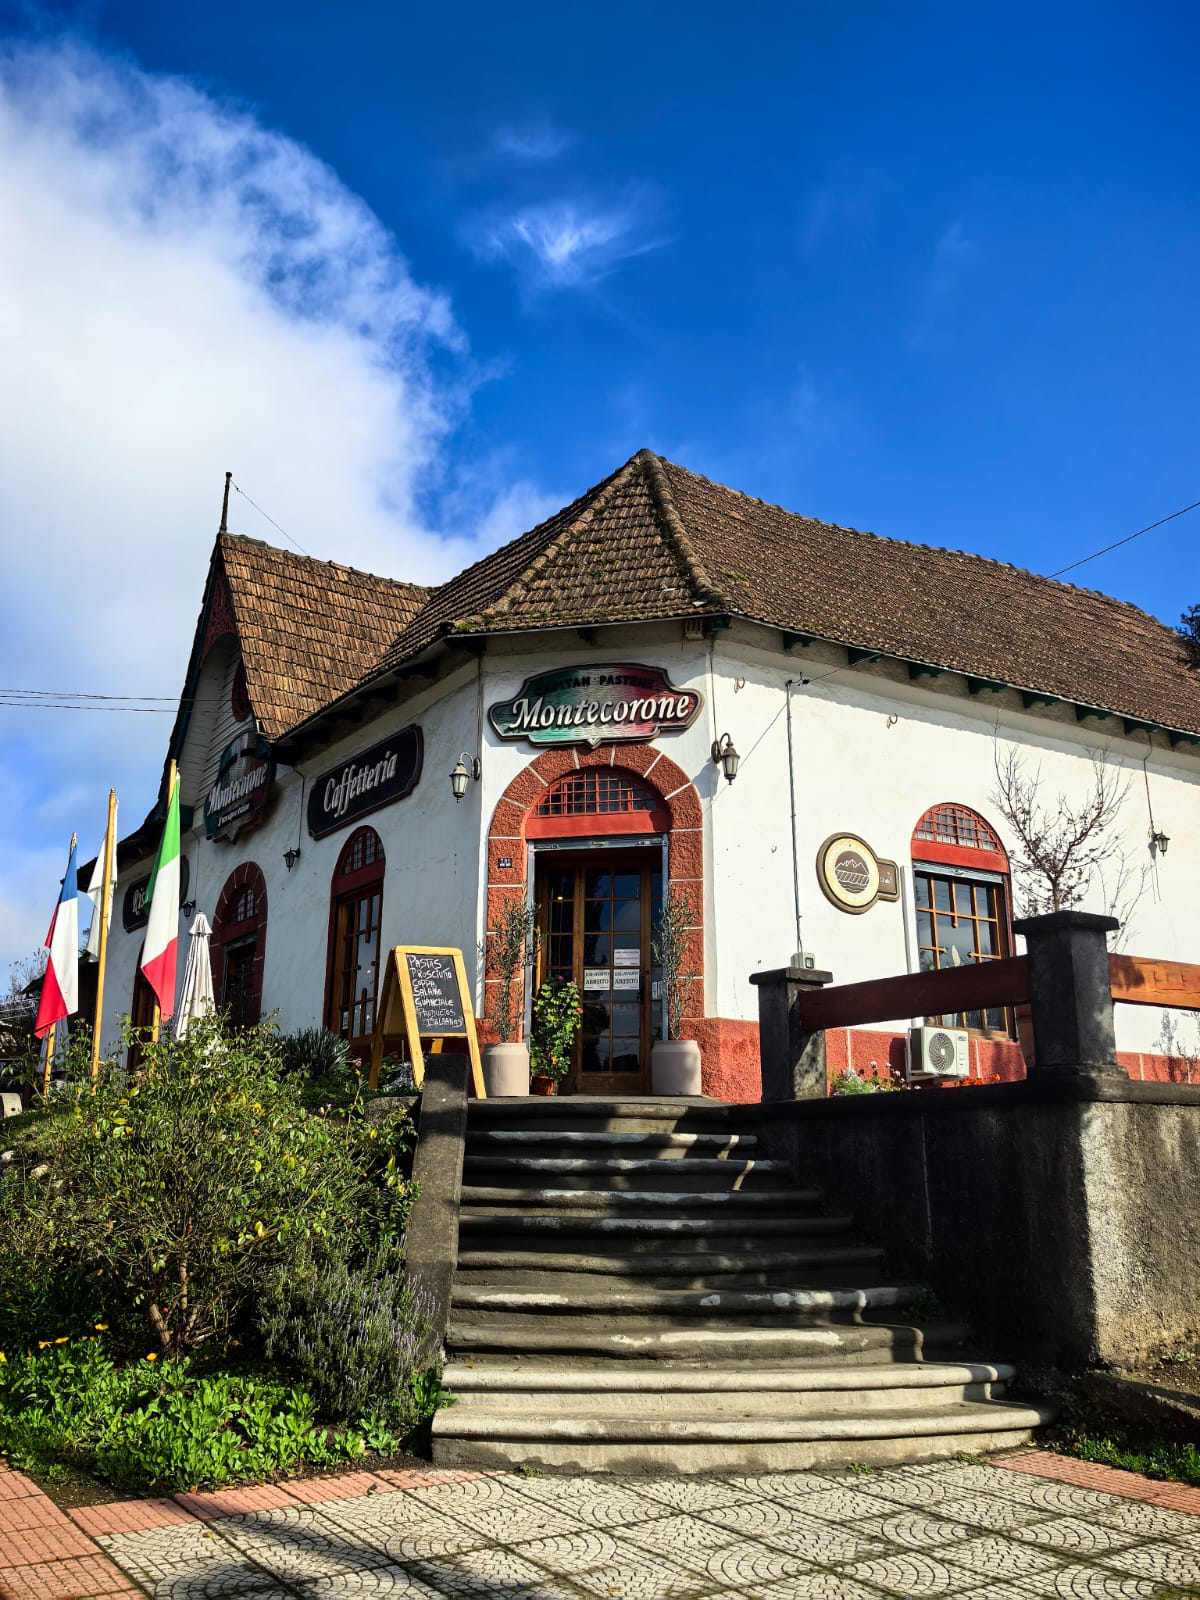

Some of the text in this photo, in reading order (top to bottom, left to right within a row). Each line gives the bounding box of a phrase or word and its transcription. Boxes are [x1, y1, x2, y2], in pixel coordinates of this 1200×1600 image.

[599, 674, 656, 690] PASTENE
[509, 694, 690, 730] Montecorone
[323, 750, 398, 818] Caffetteria
[407, 955, 442, 970] PASTAS
